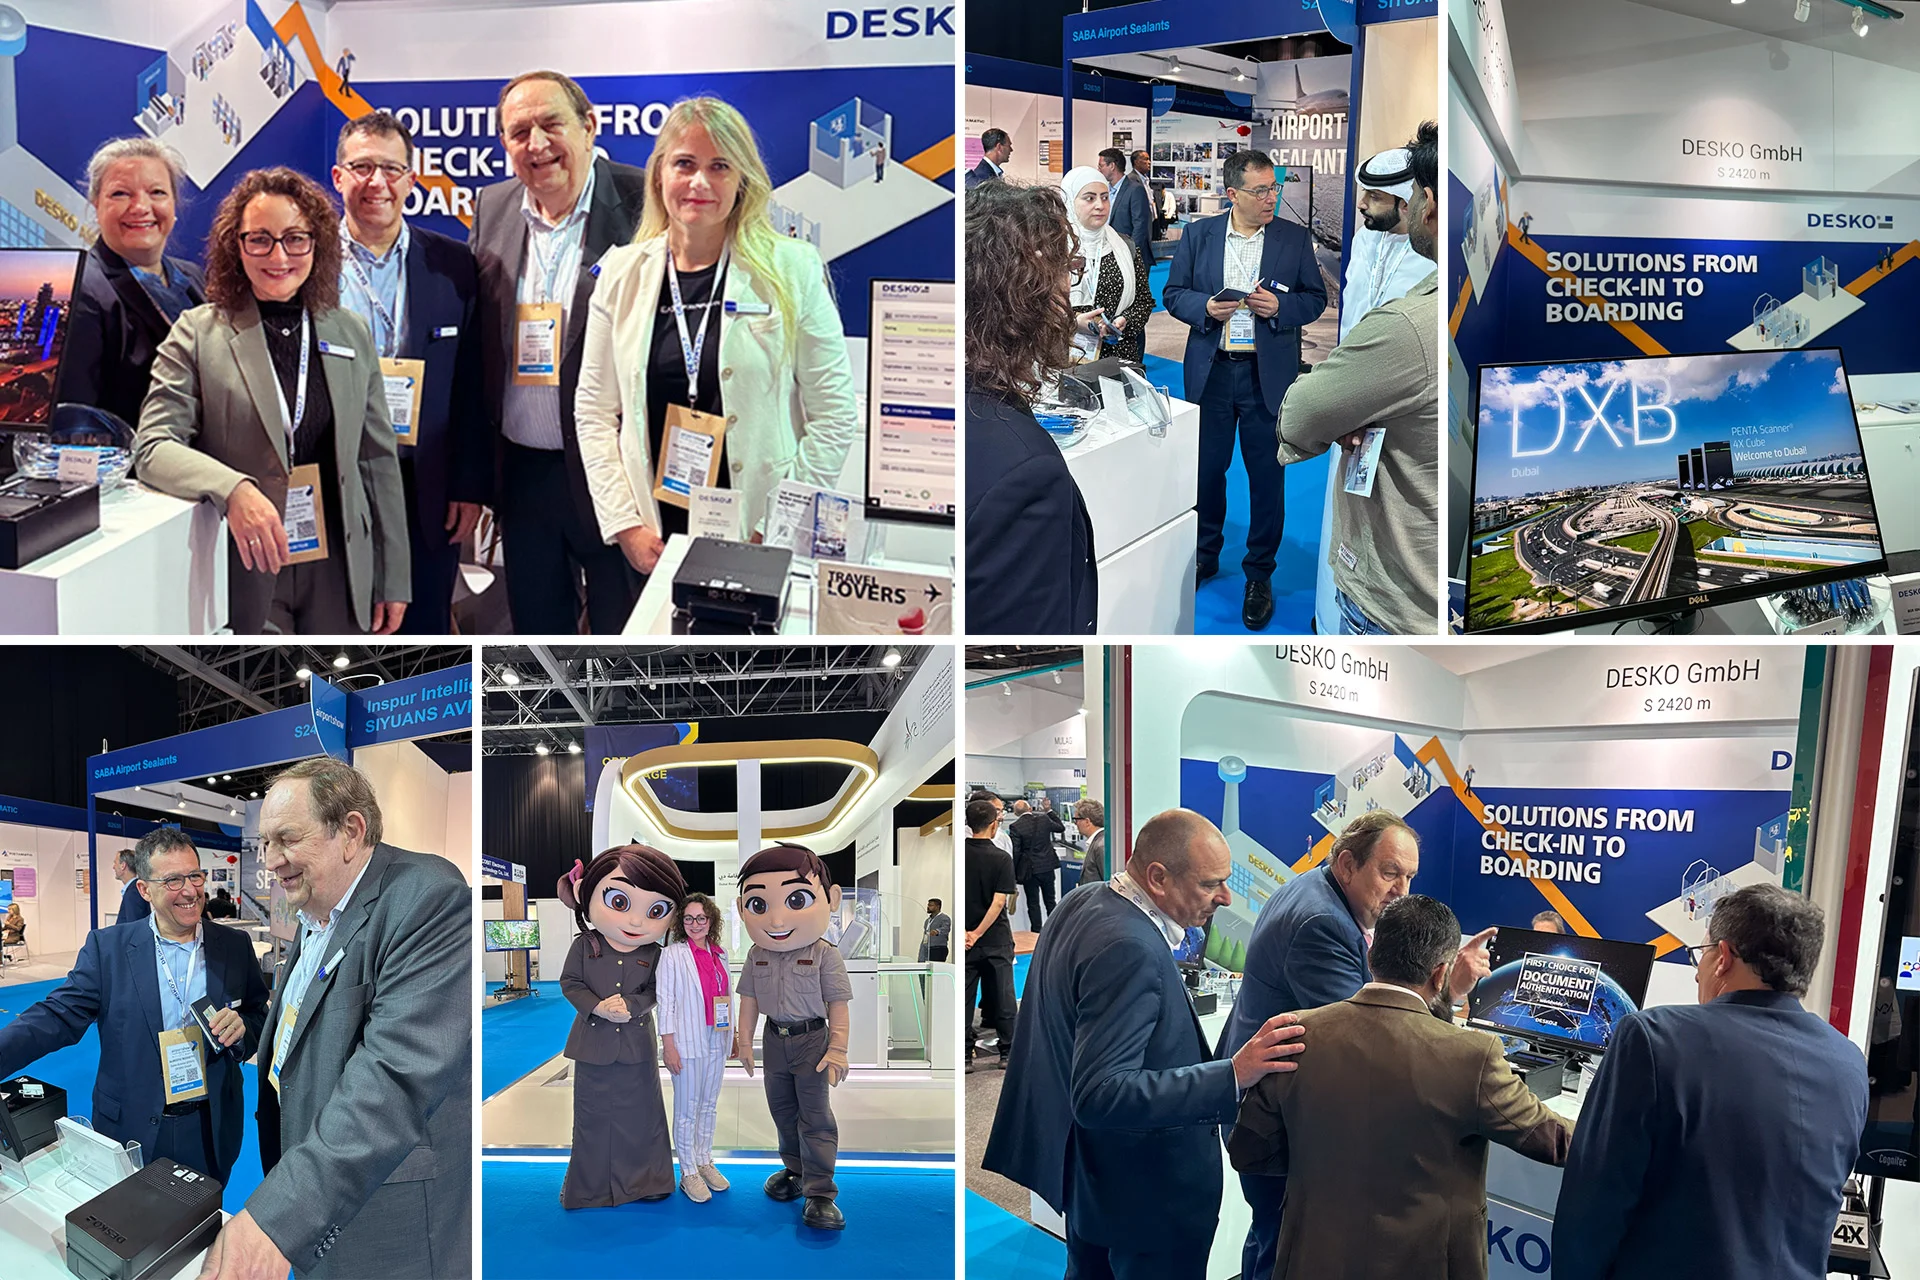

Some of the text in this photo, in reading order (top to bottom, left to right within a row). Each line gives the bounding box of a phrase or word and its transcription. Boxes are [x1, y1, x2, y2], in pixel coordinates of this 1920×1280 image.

[1072, 20, 1170, 42] SABA Airport Sealants
[594, 102, 671, 136] FRO
[1270, 112, 1346, 140] AIRPORT
[1682, 138, 1803, 162] DESKO GmbH
[1717, 167, 1771, 181] S 2420 m
[1807, 213, 1876, 229] DESKO
[1546, 252, 1758, 273] SOLUTIONS FROM
[882, 284, 920, 293] DESKO
[1545, 277, 1704, 298] CHECK-IN TO
[1545, 302, 1684, 323] BOARDING
[1511, 375, 1677, 458] DXB
[1731, 426, 1758, 436] PENTA
[1733, 440, 1766, 449] 4X Cube
[1734, 445, 1808, 462] Welcome to Dubai!
[1511, 466, 1540, 478] Dubai
[828, 570, 876, 588] TRAVEL
[827, 580, 906, 604] LOVERS
[1688, 594, 1710, 605] DELL
[1275, 645, 1388, 682] DESKO GmbH
[1606, 658, 1760, 688] DESKO GmbH
[1309, 680, 1359, 702] S 2420 m
[367, 692, 417, 713] Inspur
[1643, 697, 1711, 712] S 2420 m
[315, 707, 345, 730] airportshow
[365, 707, 438, 734] SIYUANS
[94, 755, 178, 779] SABA Airport Sealants
[1482, 804, 1695, 832] SOLUTIONS FROM
[1480, 830, 1626, 858] CHECK-IN TO
[1480, 855, 1602, 884] BOARDING
[1526, 958, 1597, 976] FIRST CHOICE FOR
[1522, 969, 1594, 991] DOCUMENT
[1519, 981, 1590, 1001] AUTHENTICATION
[1879, 1153, 1908, 1167] Cognitec
[1833, 1223, 1866, 1246] 4X
